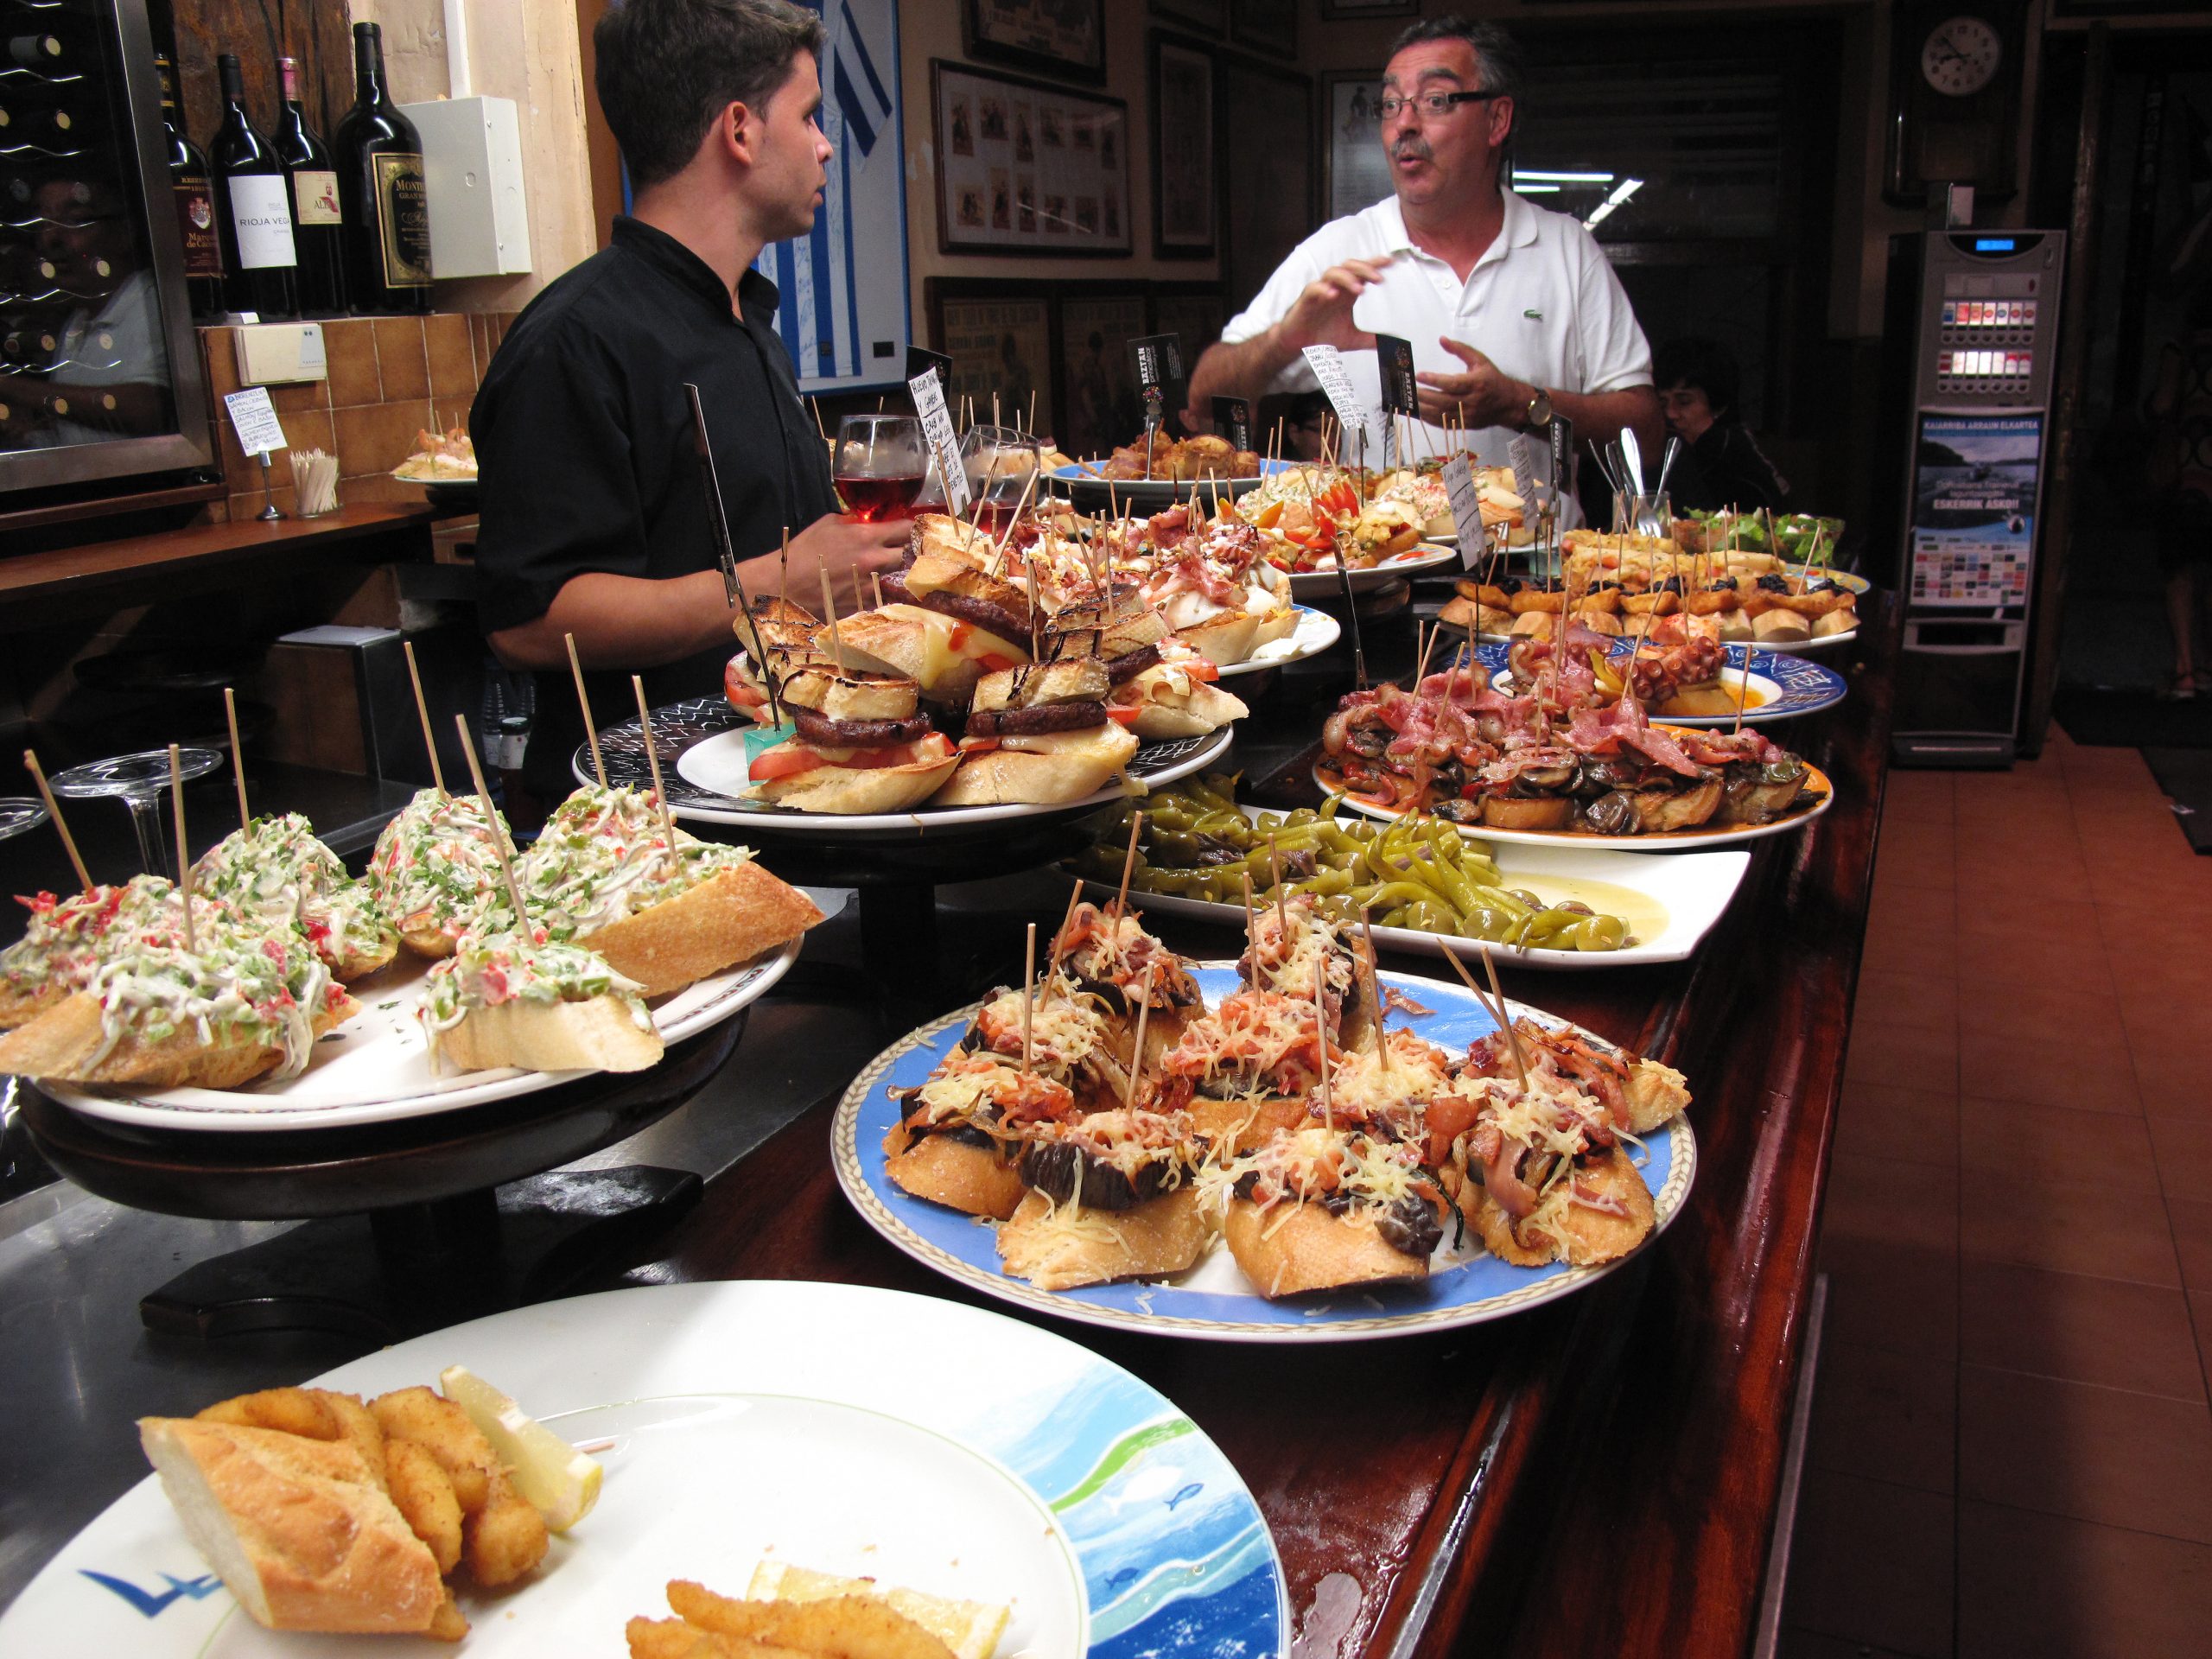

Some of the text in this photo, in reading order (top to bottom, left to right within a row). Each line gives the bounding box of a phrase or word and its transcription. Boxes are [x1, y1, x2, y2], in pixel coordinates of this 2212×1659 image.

[239, 218, 270, 226] RIOJA
[1137, 347, 1150, 385] BAZTAN
[925, 417, 938, 434] CRAB
[1933, 499, 1984, 510] ESKERRIK
